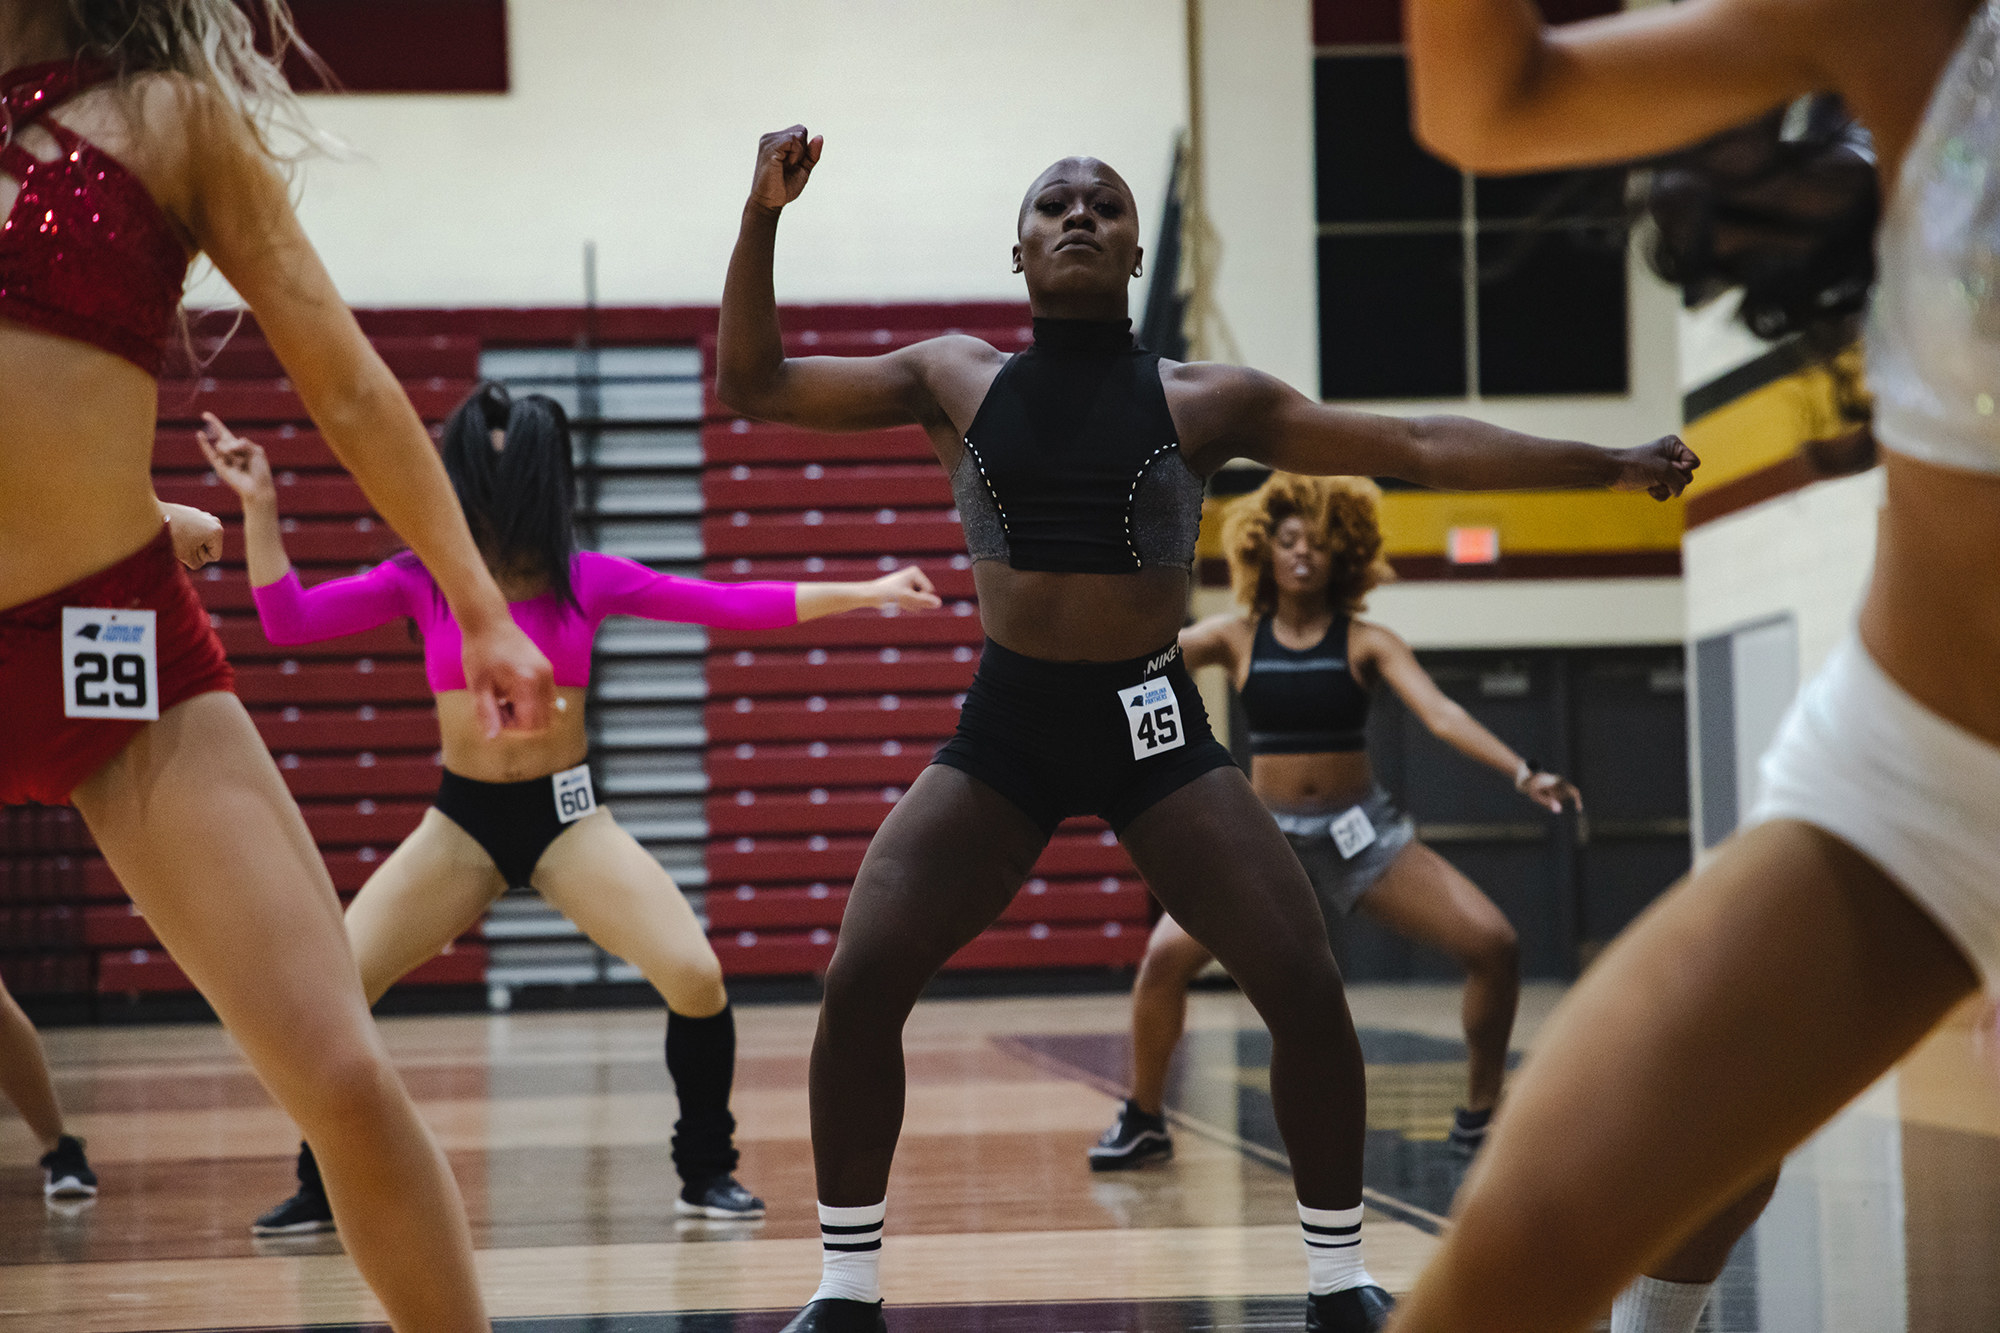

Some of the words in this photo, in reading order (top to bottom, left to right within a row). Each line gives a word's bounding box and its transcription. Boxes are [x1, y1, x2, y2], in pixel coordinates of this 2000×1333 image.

[1146, 644, 1176, 674] NIKE
[74, 652, 146, 707] 29
[1145, 687, 1167, 698] CAROLINA
[1145, 694, 1168, 705] PANTHERS
[1137, 705, 1178, 750] 45
[560, 787, 590, 816] 60
